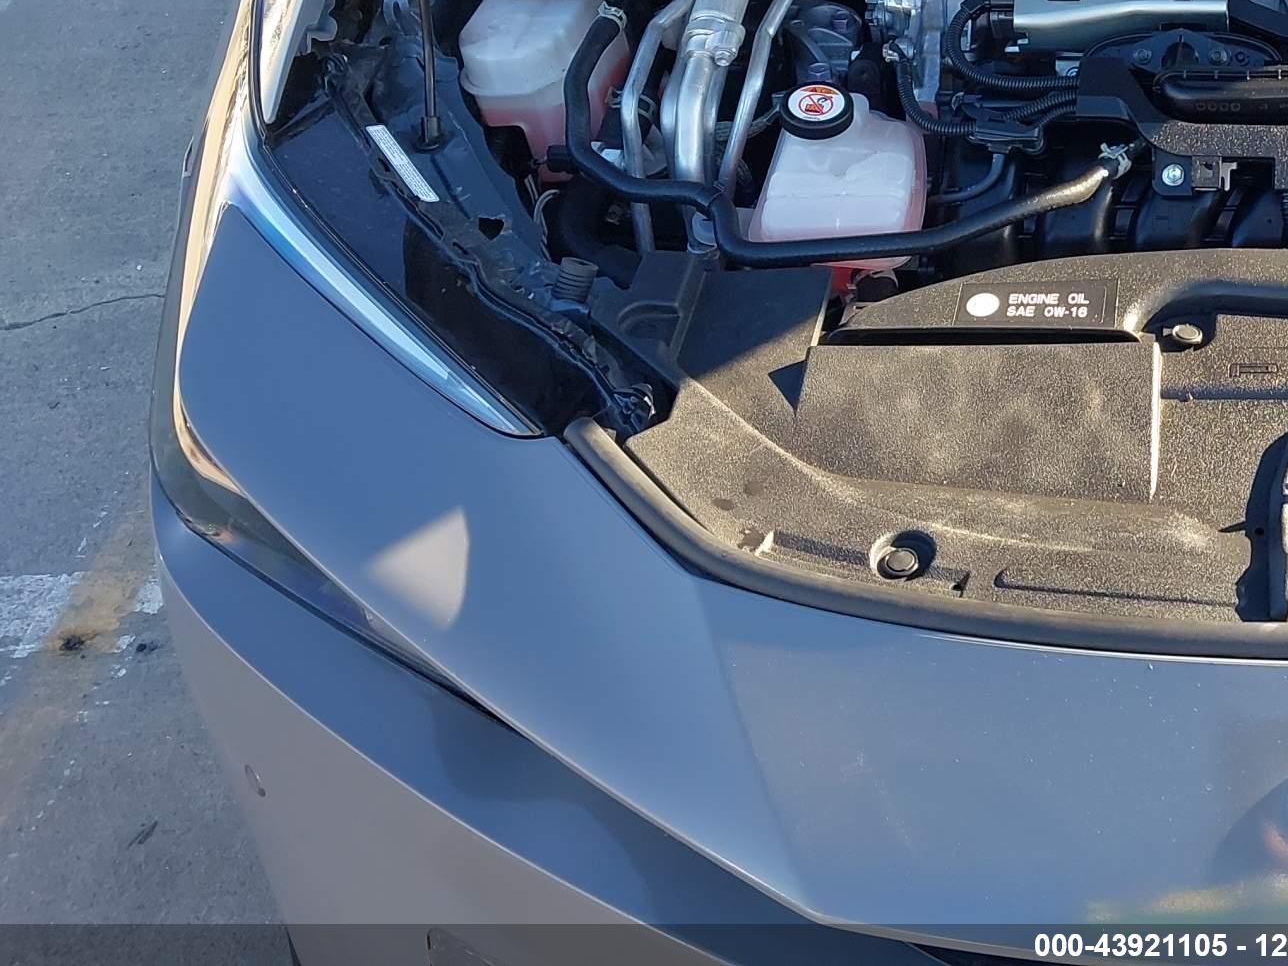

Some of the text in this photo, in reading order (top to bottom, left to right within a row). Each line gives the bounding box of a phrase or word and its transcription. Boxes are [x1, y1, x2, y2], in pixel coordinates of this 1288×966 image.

[1008, 293, 1090, 305] ENGINE OIL
[1006, 306, 1089, 318] SAE 0W-16
